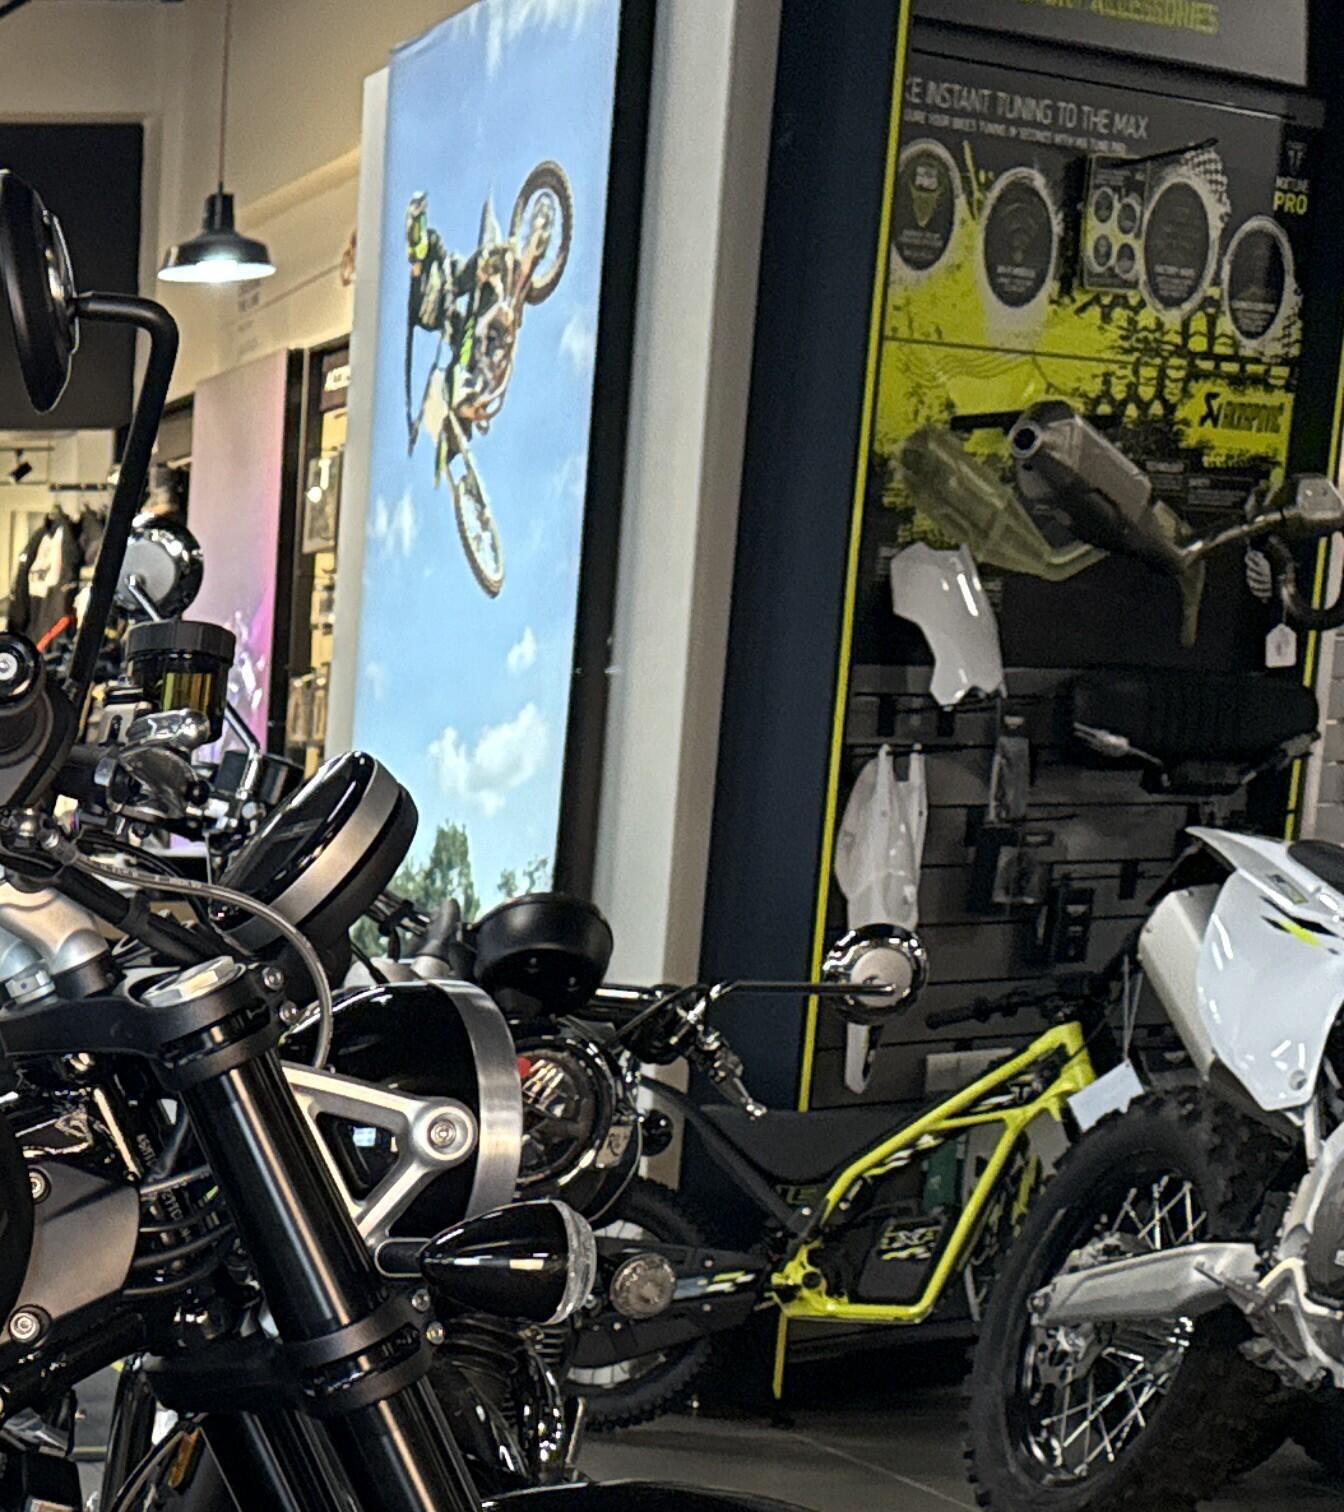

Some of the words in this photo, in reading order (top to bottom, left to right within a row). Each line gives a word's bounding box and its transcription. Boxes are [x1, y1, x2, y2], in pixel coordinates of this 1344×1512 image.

[926, 80, 993, 115] INSTANT
[996, 91, 1054, 125] TUNING
[1057, 101, 1078, 128] TO
[1081, 105, 1111, 134] THE
[1112, 112, 1150, 139] MAX
[1273, 191, 1309, 215] PRO
